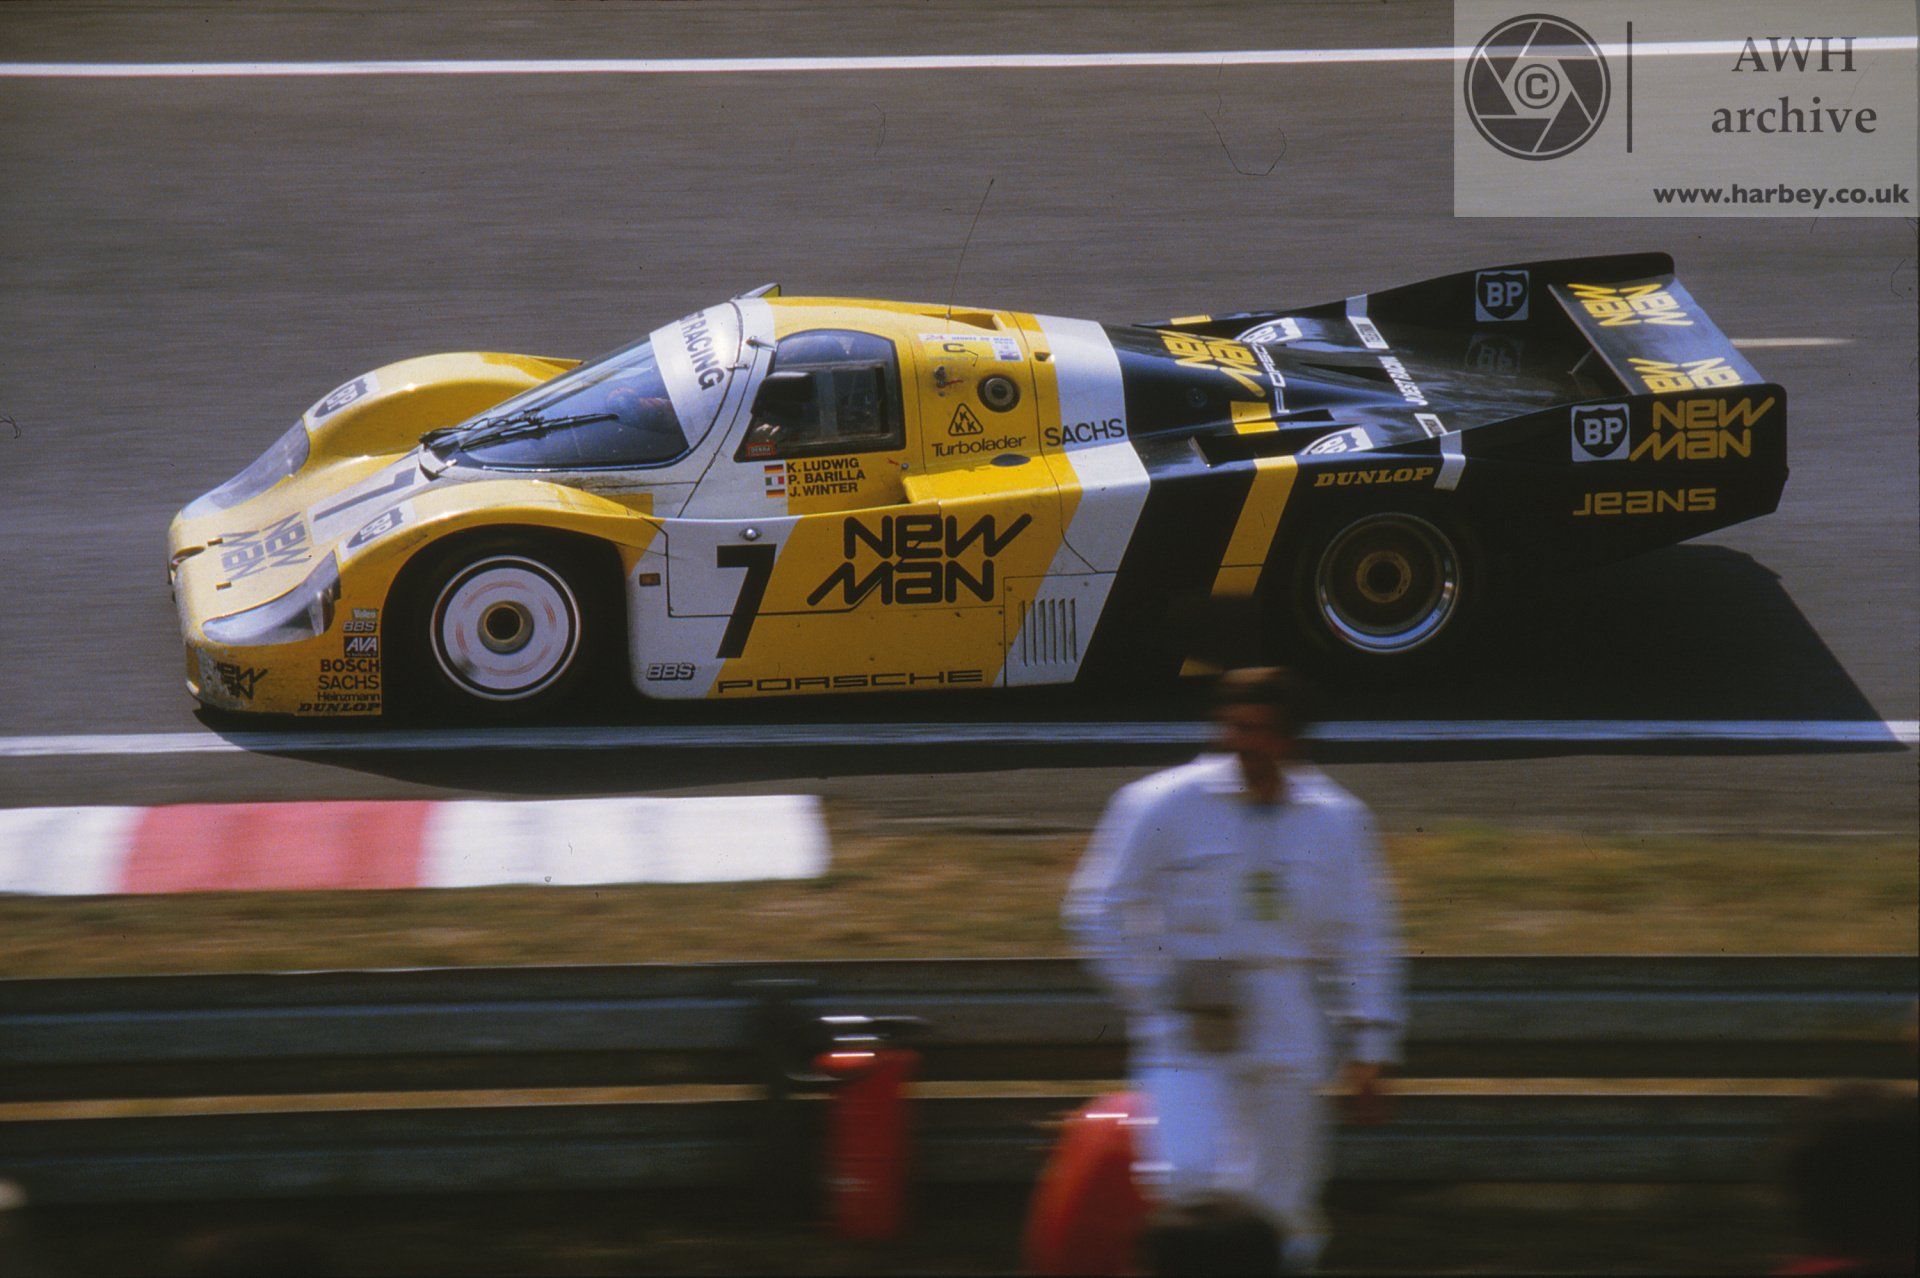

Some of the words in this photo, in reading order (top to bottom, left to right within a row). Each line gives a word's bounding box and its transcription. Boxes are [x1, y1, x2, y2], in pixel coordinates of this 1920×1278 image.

[1485, 281, 1524, 308] BP
[681, 318, 725, 391] RACING
[1044, 418, 1125, 447] SACHS
[1583, 417, 1623, 446] BP
[931, 435, 1026, 457] Turbolader
[787, 462, 801, 474] K.
[803, 458, 858, 472] LUDWIG
[788, 474, 801, 485] P.
[804, 470, 865, 483] BARILLA
[1314, 467, 1434, 488] DUNLOP
[788, 486, 801, 498] J.
[803, 483, 858, 496] WINTER
[716, 543, 777, 659] 7
[343, 621, 377, 633] BBS
[346, 637, 377, 652] AVA
[320, 659, 380, 673] BOSCH
[646, 663, 695, 680] BBS
[318, 675, 380, 690] SACHS
[718, 669, 983, 693] PORSCHE
[317, 691, 381, 703] Heinzmann
[297, 703, 381, 712] DUNLOP
